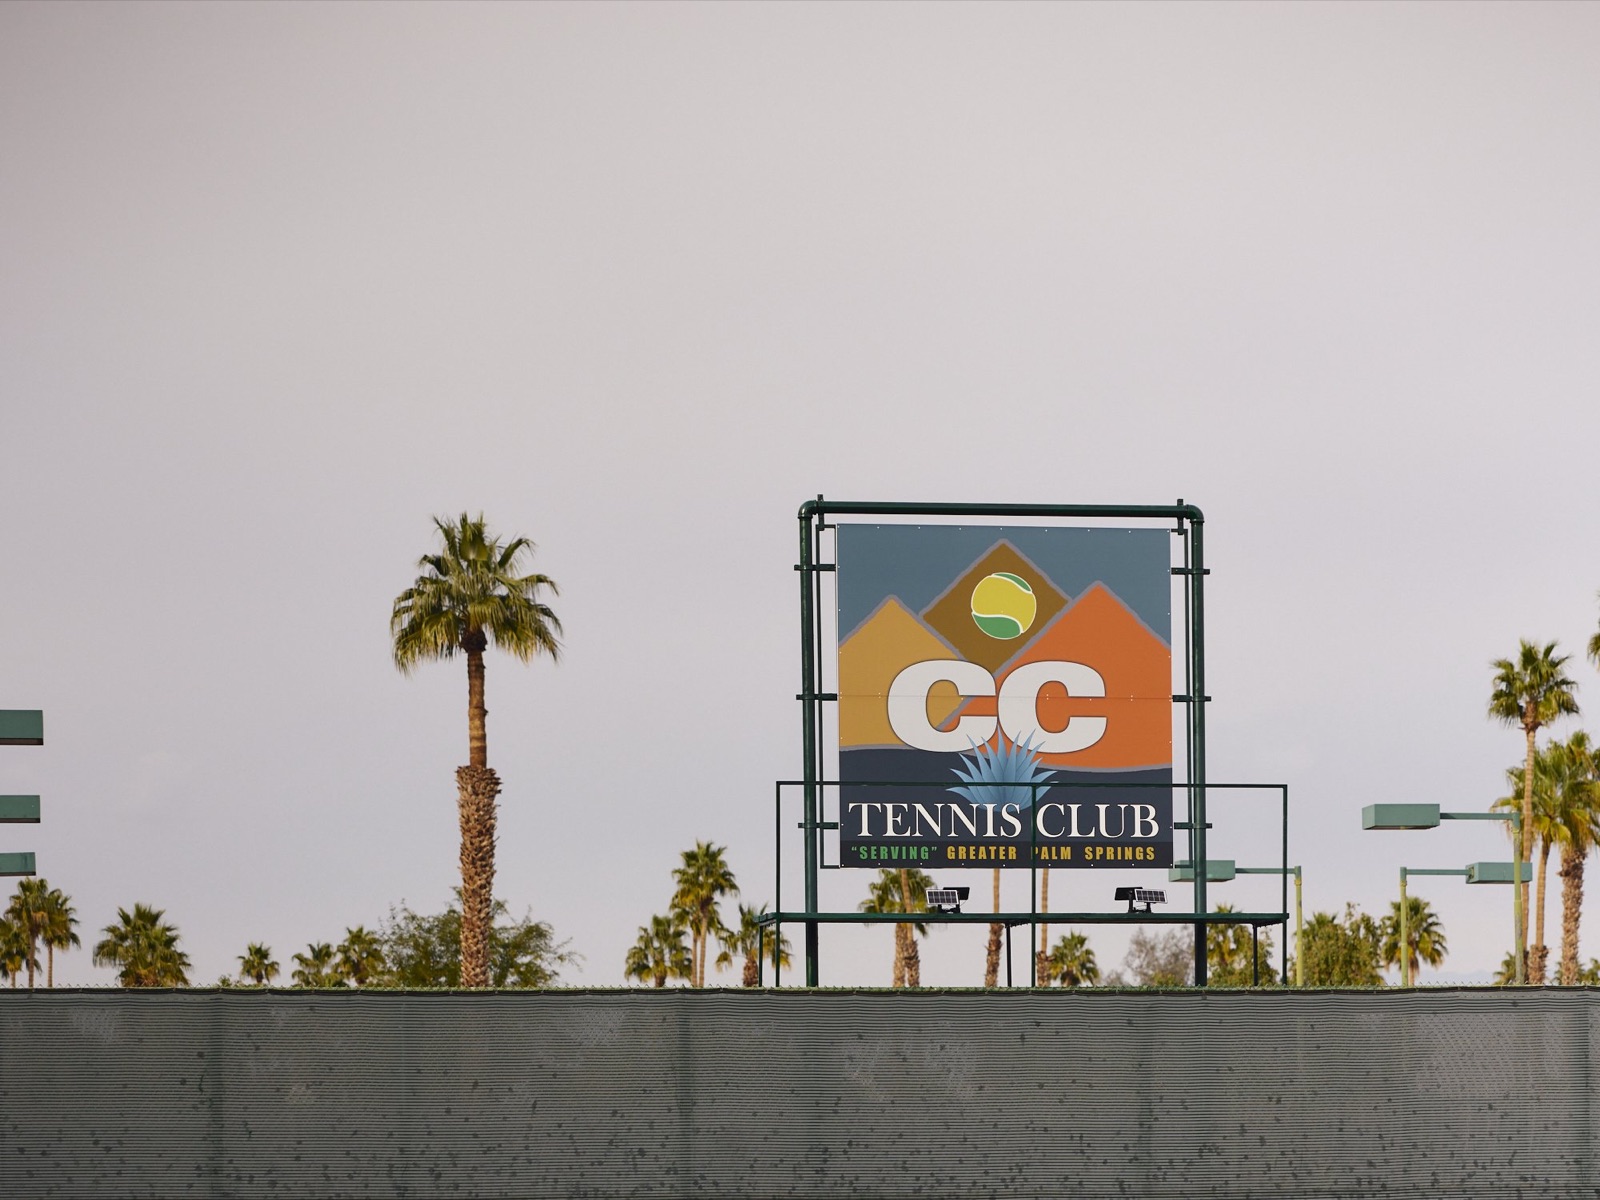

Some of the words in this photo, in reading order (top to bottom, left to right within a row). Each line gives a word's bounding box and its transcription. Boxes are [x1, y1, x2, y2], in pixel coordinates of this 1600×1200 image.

[888, 660, 1107, 753] CC
[848, 803, 1022, 838] TENNIS
[1036, 803, 1160, 838] CLUB
[851, 845, 937, 860] “SERVING”
[947, 846, 1017, 860] GREATER
[1085, 847, 1155, 861] SPRINGS
